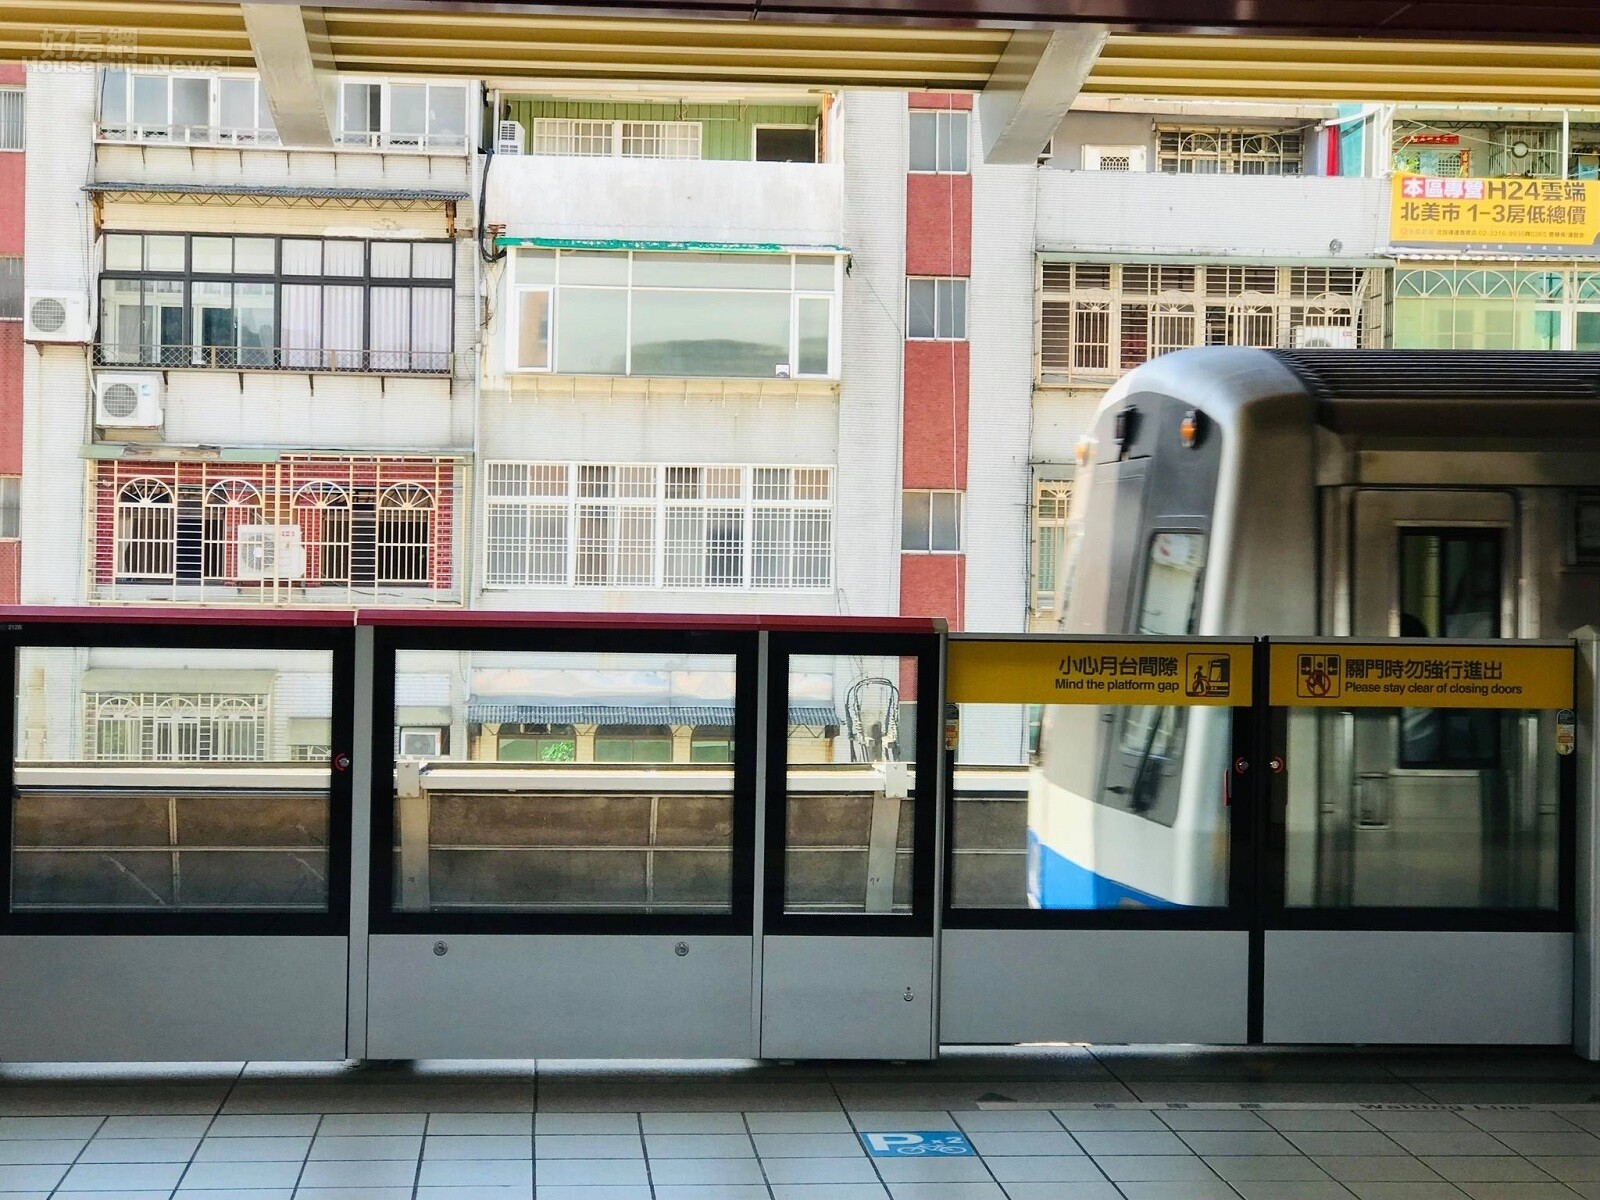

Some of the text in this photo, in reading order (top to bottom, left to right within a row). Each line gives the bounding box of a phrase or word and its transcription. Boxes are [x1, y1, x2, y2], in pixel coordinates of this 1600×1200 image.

[1403, 177, 1586, 202] 本區專營 H24雲端
[1400, 202, 1586, 225] 北美市 1-3房低總價
[1059, 655, 1179, 677] 小心月台間隙
[1345, 659, 1502, 681] 關門時勿強行進出
[1055, 678, 1179, 693] Mind the platform gap
[1345, 682, 1523, 696] Please stay clear of closing doors
[867, 1132, 924, 1151] P
